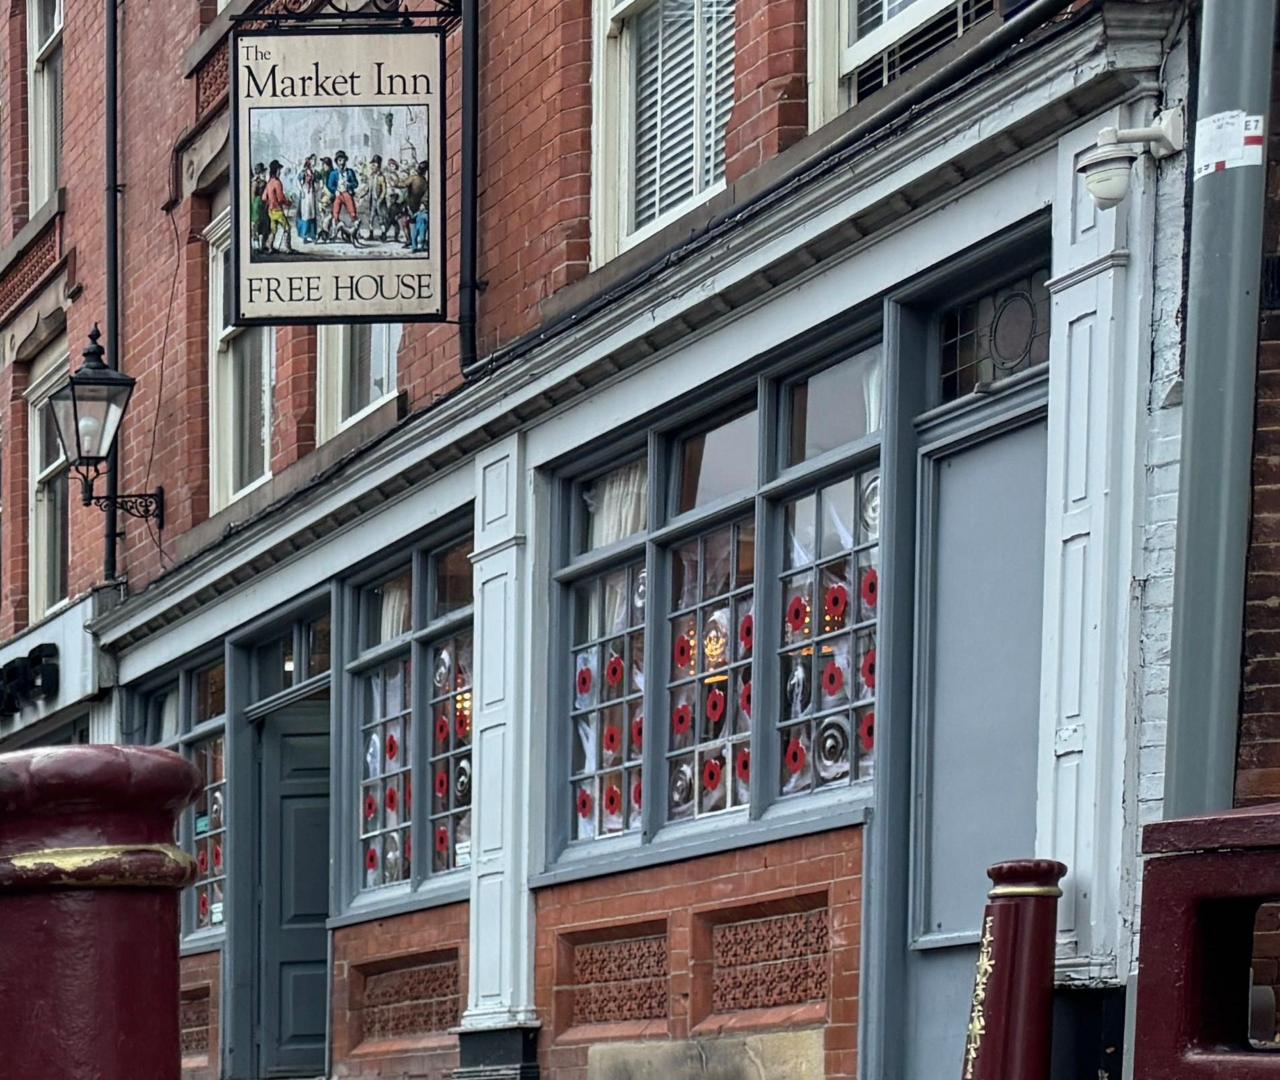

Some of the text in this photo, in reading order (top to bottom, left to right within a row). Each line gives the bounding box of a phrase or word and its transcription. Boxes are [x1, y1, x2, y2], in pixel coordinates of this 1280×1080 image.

[241, 45, 272, 61] The
[243, 61, 434, 99] Market Inn
[246, 273, 434, 304] FREE HOUSE
